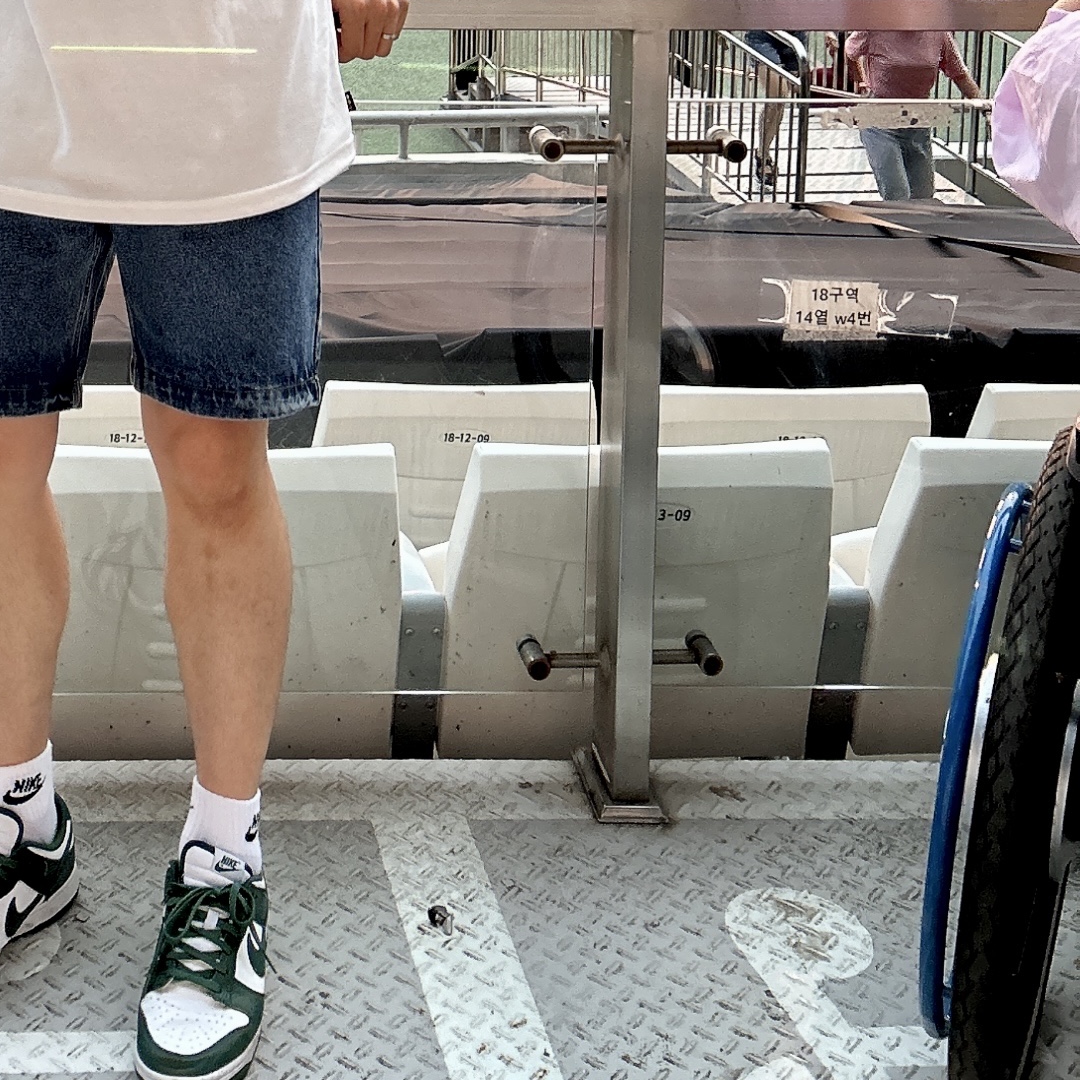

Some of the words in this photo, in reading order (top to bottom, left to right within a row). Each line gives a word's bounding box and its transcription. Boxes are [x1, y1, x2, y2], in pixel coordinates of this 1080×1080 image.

[811, 287, 859, 303] 18구역
[796, 310, 828, 325] 14열
[835, 310, 872, 326] w4번
[110, 434, 143, 443] 18-12-
[443, 433, 490, 443] 18-12-09
[657, 509, 691, 521] 3-09
[13, 773, 43, 795] NIKE
[220, 855, 239, 869] NIKE
